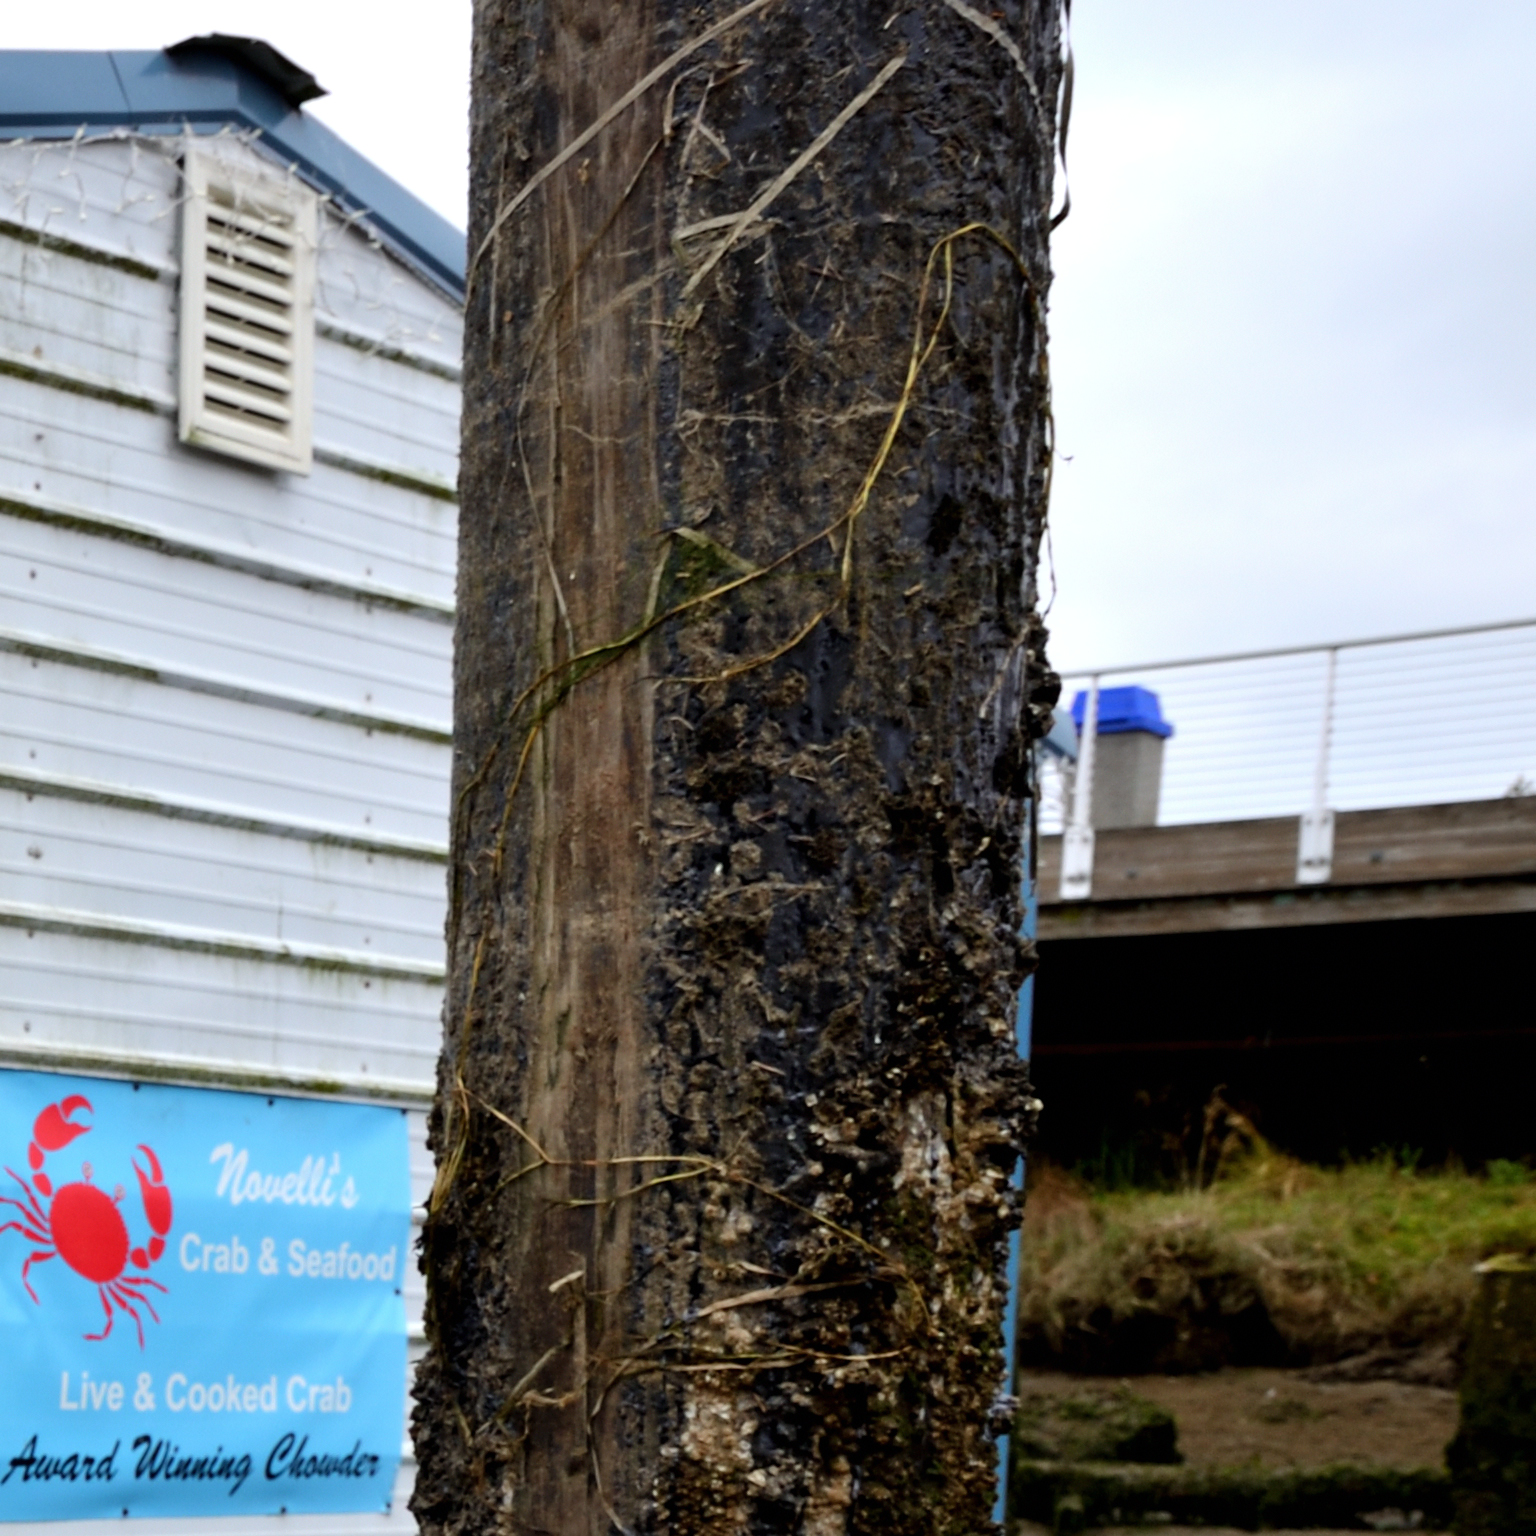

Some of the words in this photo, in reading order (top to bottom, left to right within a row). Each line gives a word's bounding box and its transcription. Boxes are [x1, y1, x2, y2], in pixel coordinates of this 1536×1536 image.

[209, 1142, 360, 1209] Novelli's
[179, 1232, 249, 1275] Crab
[258, 1236, 279, 1276] &
[287, 1238, 397, 1281] Seafood
[59, 1371, 125, 1411] Live
[133, 1371, 157, 1412] &
[165, 1372, 277, 1413] Cooked
[285, 1374, 352, 1413] Crab
[0, 1433, 121, 1486] Award
[131, 1433, 253, 1497] Winning
[264, 1431, 380, 1481] Chowder
